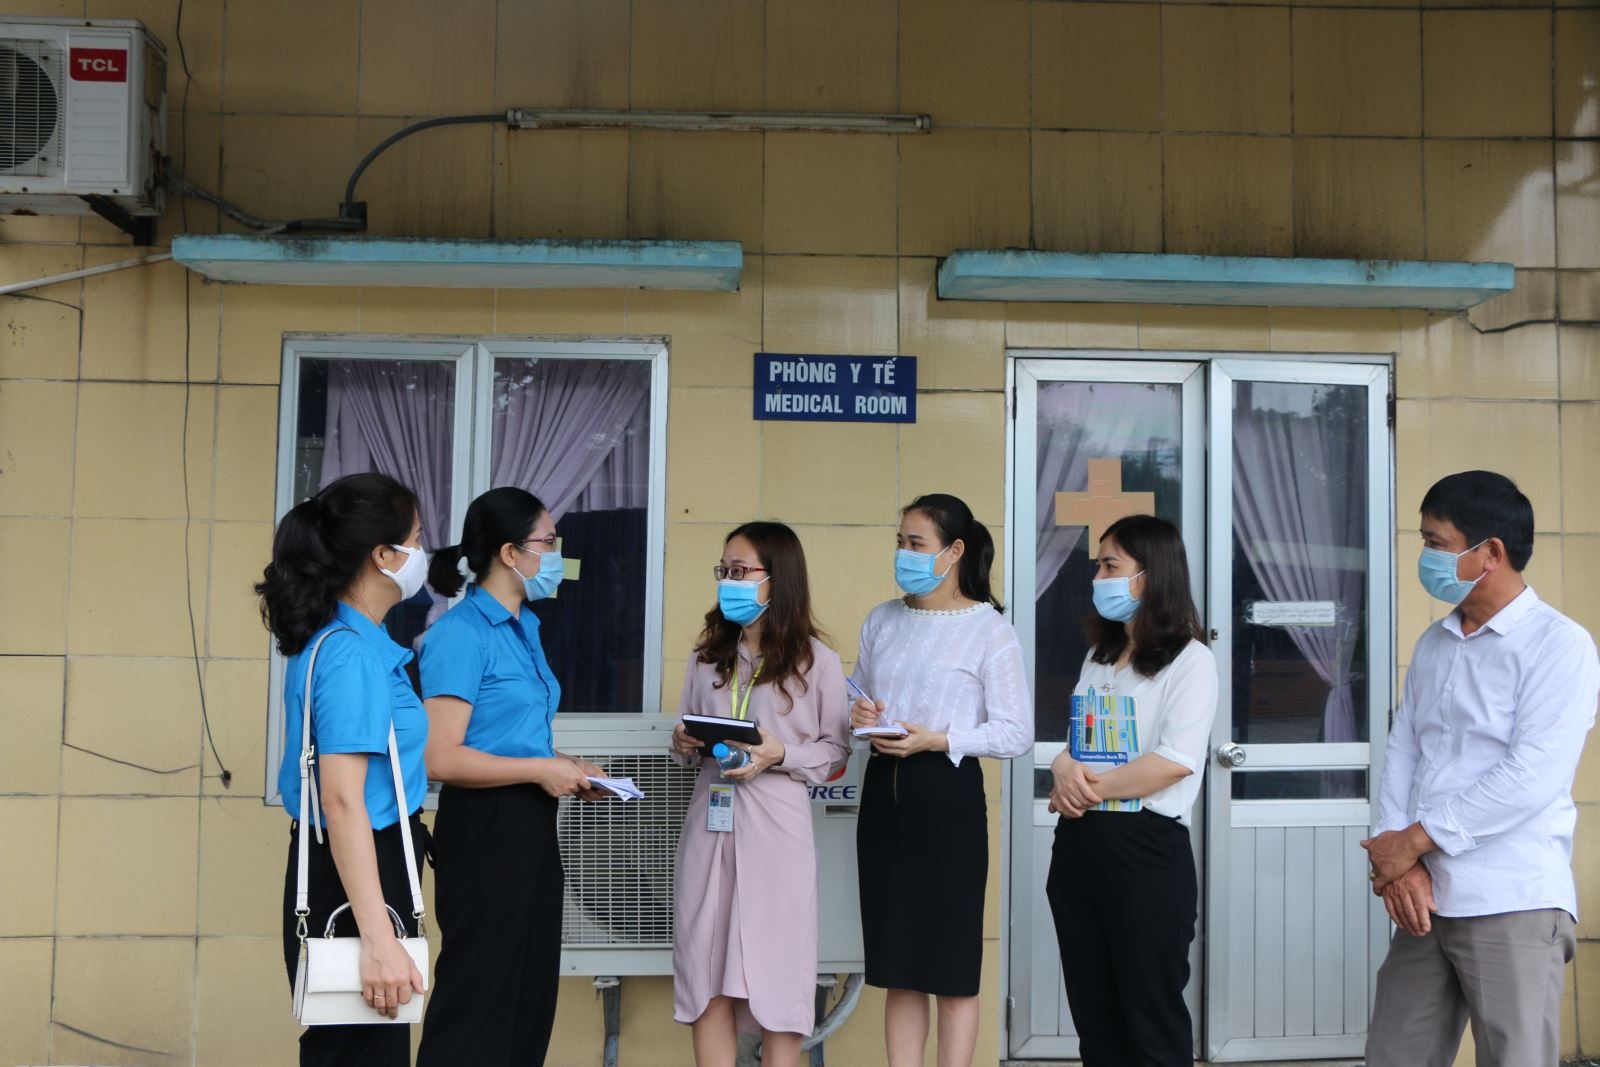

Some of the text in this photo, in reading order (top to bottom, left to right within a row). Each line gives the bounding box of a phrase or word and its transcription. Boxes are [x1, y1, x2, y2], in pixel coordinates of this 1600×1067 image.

[78, 58, 119, 71] TCL
[769, 357, 897, 385] PHÒNG Y TẾ
[765, 393, 907, 415] MEDICAL ROOM
